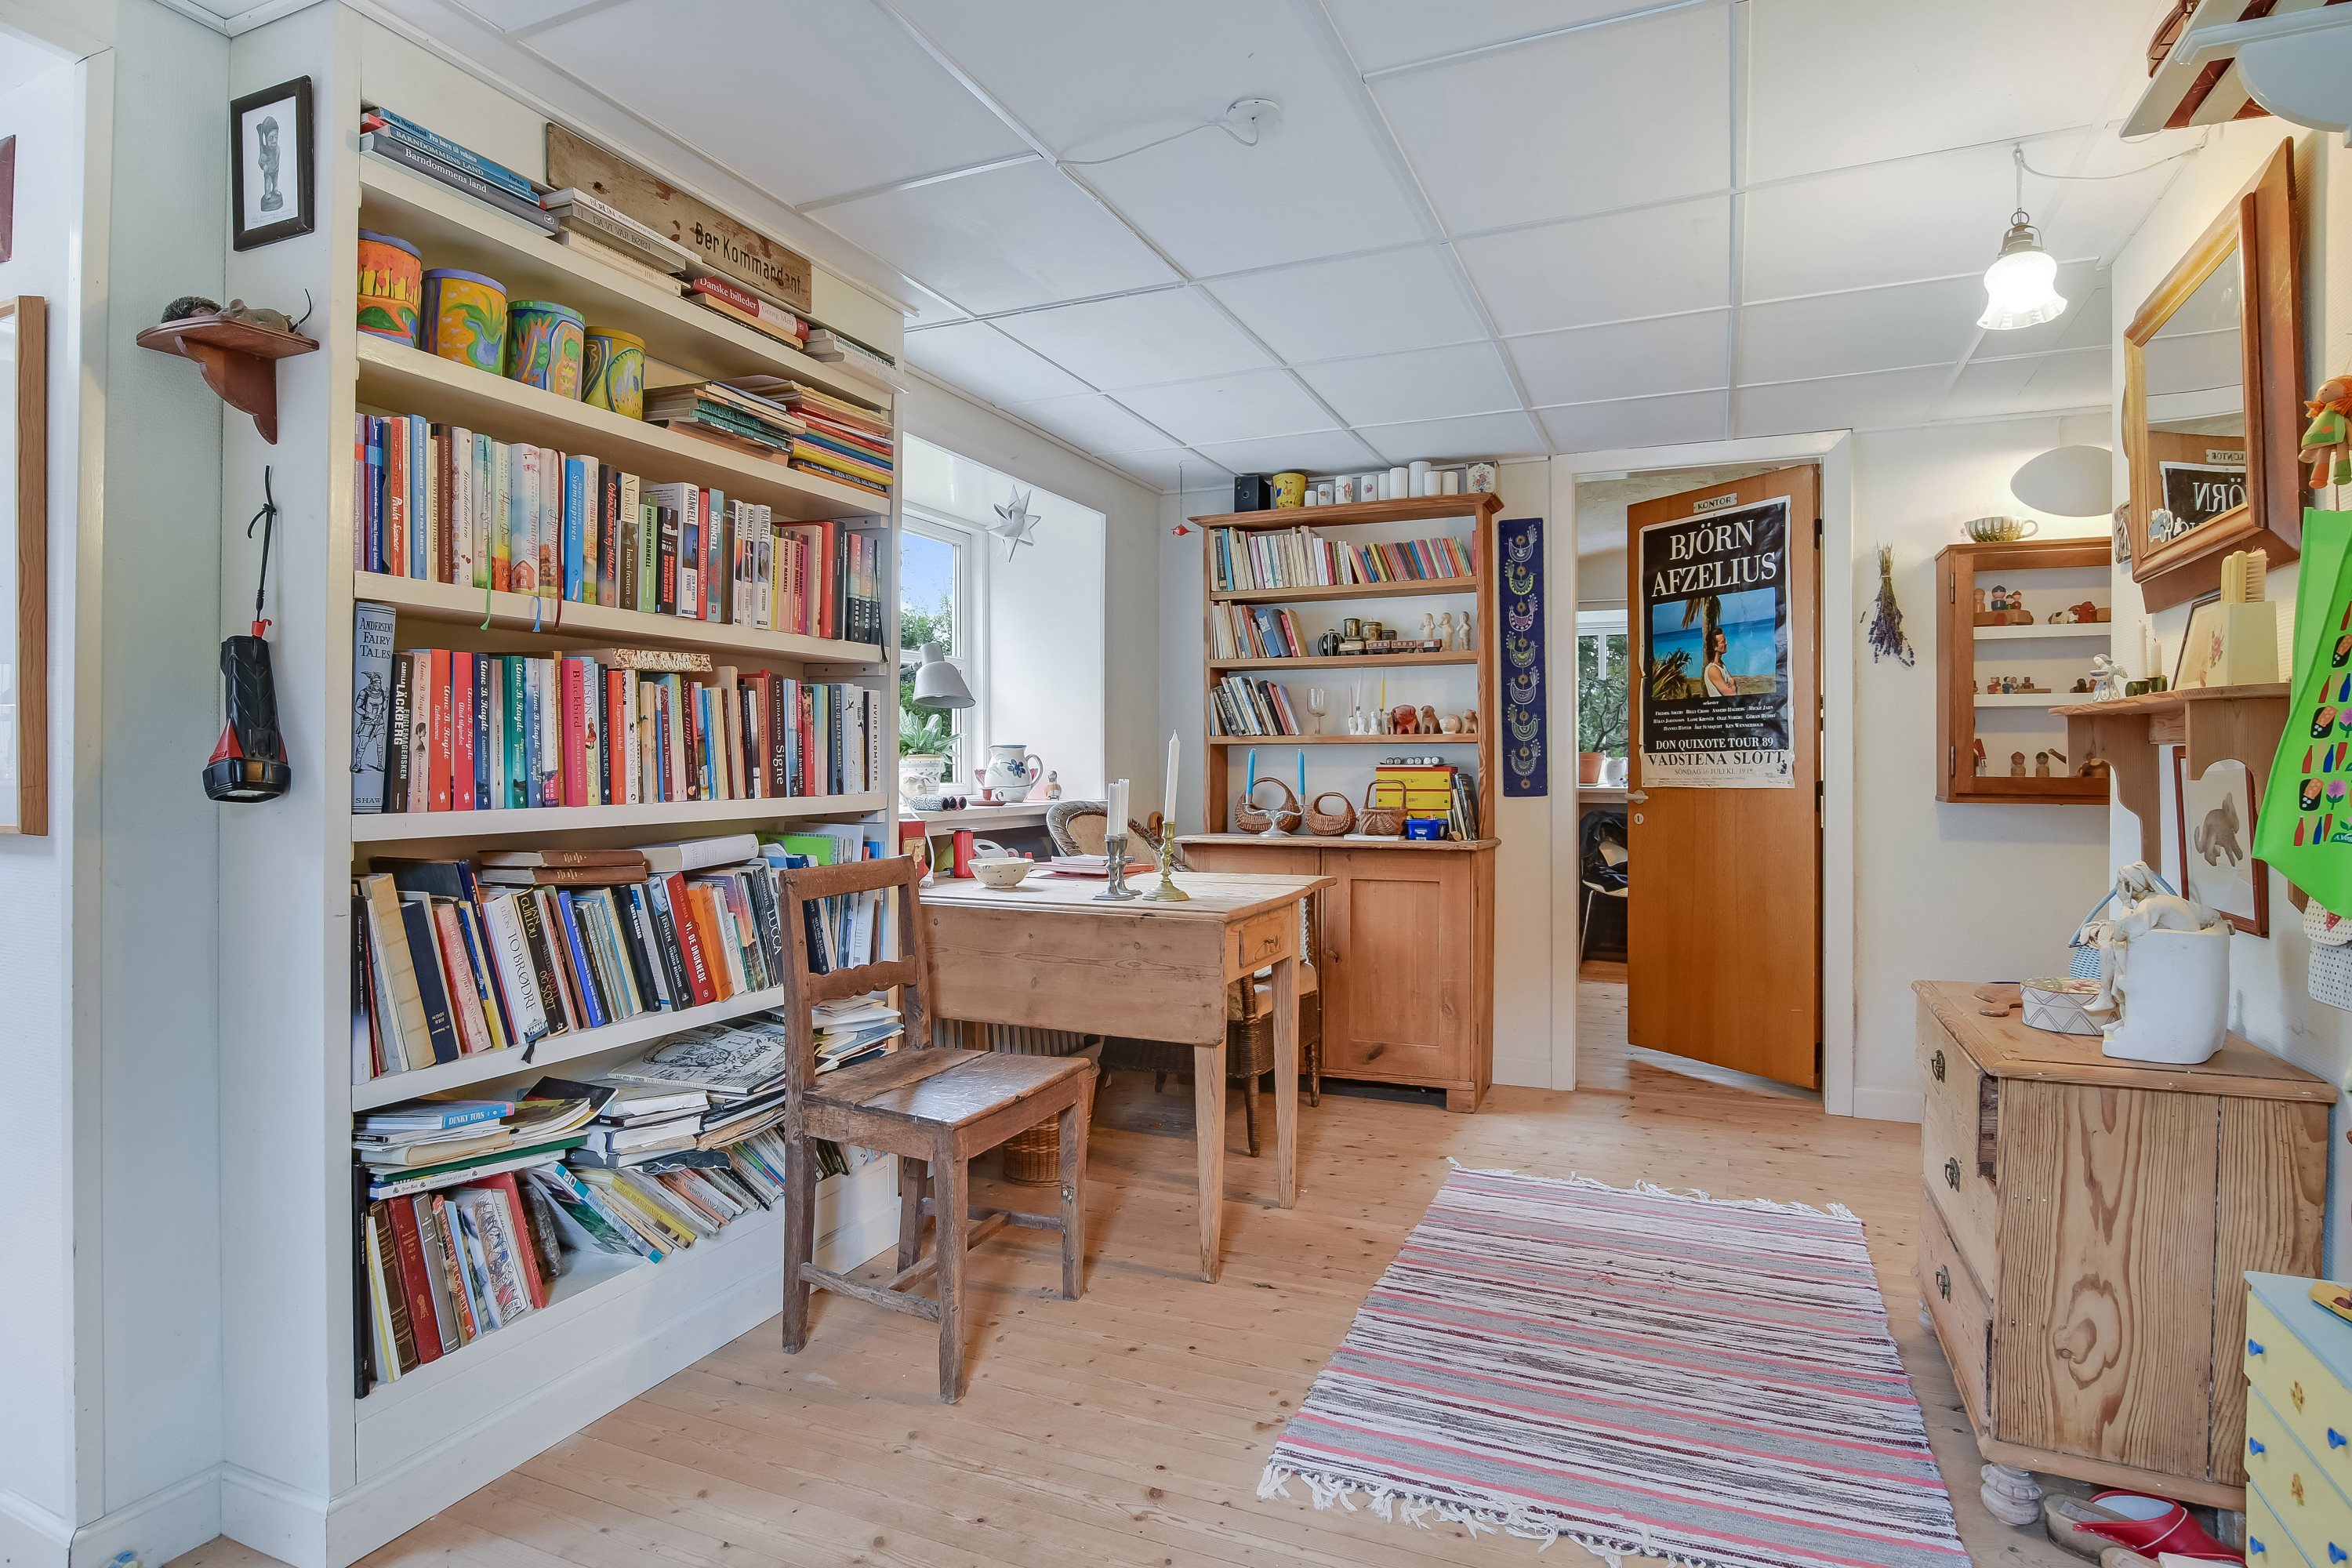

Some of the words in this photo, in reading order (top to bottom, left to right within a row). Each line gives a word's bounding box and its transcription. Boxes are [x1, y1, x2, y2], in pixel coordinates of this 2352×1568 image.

[396, 130, 461, 165] BARNDOMMENS
[463, 162, 484, 176] LAND
[405, 148, 467, 183] Barndommens
[470, 178, 487, 193] land
[508, 174, 524, 187] Forum
[590, 198, 615, 217] BERLIN
[593, 216, 604, 228] DA
[605, 223, 614, 232] VI
[615, 226, 629, 241] VAR
[631, 234, 651, 251] BØRN
[695, 221, 720, 252] Der
[723, 235, 801, 295] Kommandant
[699, 278, 728, 296] Danske
[730, 286, 757, 310] billeder
[761, 305, 779, 323] Georg
[392, 496, 402, 521] Paula
[624, 477, 636, 519] Mankell
[687, 488, 697, 523] MANKELL
[1697, 496, 1732, 510] KONTOR
[392, 524, 402, 552] Spencer
[760, 509, 769, 540] MANKELL
[1669, 520, 1755, 561] BJÖRN
[1651, 551, 1777, 597] AFZELIUS
[360, 645, 390, 659] TALES
[363, 632, 390, 645] FAIRY
[481, 687, 488, 698] B.
[516, 689, 523, 699] B.
[572, 670, 582, 728] Blackbird
[584, 663, 593, 715] WATSON
[394, 684, 407, 746] LÄCKBERG
[444, 712, 450, 724] B.
[478, 701, 488, 731] Ragde
[514, 702, 524, 732] Ragde
[400, 710, 410, 779] ENGLEMAGERSKEN
[440, 727, 450, 759] Ragde
[532, 723, 540, 749] Ragde
[1656, 740, 1676, 750] DON
[1678, 739, 1726, 751] QUIXOTE
[1727, 738, 1759, 748] TOUR
[1762, 737, 1773, 746] 89
[773, 745, 784, 785] Signe
[1647, 753, 1727, 766] VADSTENA
[1733, 751, 1784, 764] SLOTT
[630, 779, 636, 789] BY
[520, 896, 539, 938] GUILLOU
[529, 906, 541, 925] JAN
[758, 872, 770, 907] GRØNDAHL
[767, 909, 782, 955] LUCCA
[506, 929, 521, 953] TO
[659, 915, 672, 942] JENSEN
[684, 921, 694, 935] VI,
[688, 935, 696, 945] DE
[539, 970, 549, 985] OG
[673, 967, 682, 988] BEGYNDE
[690, 946, 706, 984] DRUKNEDE
[512, 953, 537, 1013] BRØDRE
[541, 985, 556, 1011] SORT
[448, 1113, 469, 1125] DINKY
[470, 1111, 485, 1121] TOYS
[437, 1201, 452, 1243] NORDISKE
[447, 1243, 460, 1274] GUDER
[455, 1274, 463, 1293] OG
[457, 1292, 469, 1316] HELTE
